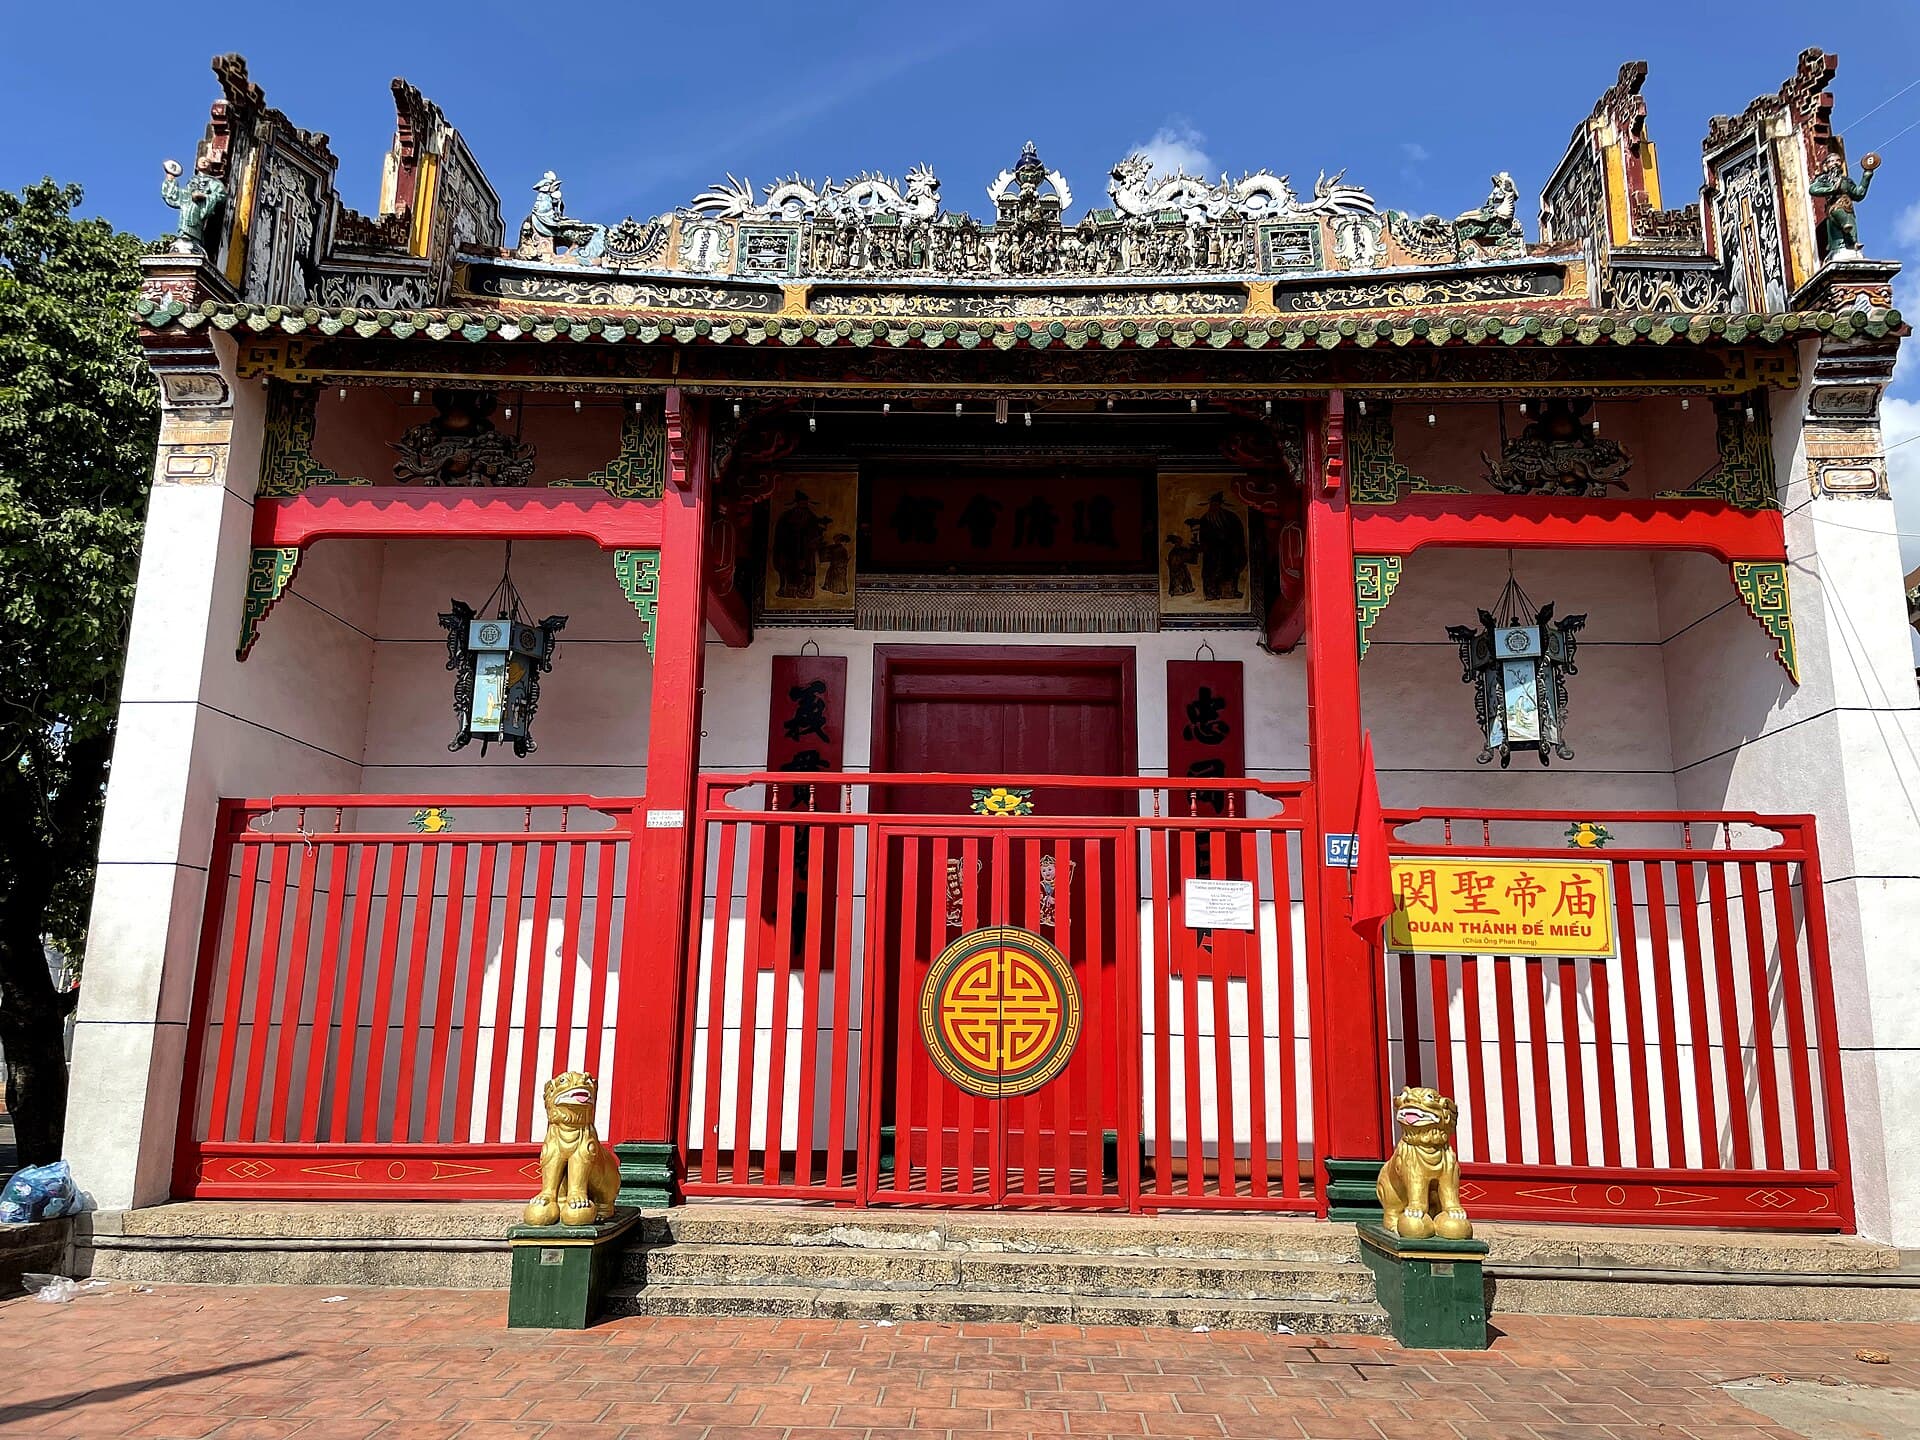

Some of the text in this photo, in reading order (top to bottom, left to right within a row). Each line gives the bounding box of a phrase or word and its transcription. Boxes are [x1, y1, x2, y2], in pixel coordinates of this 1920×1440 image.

[1330, 839, 1359, 856] 579
[1408, 919, 1591, 937] QUAN THÁNH ĐẾ MIẾU
[1484, 936, 1498, 946] Ông
[1499, 938, 1516, 946] Phan
